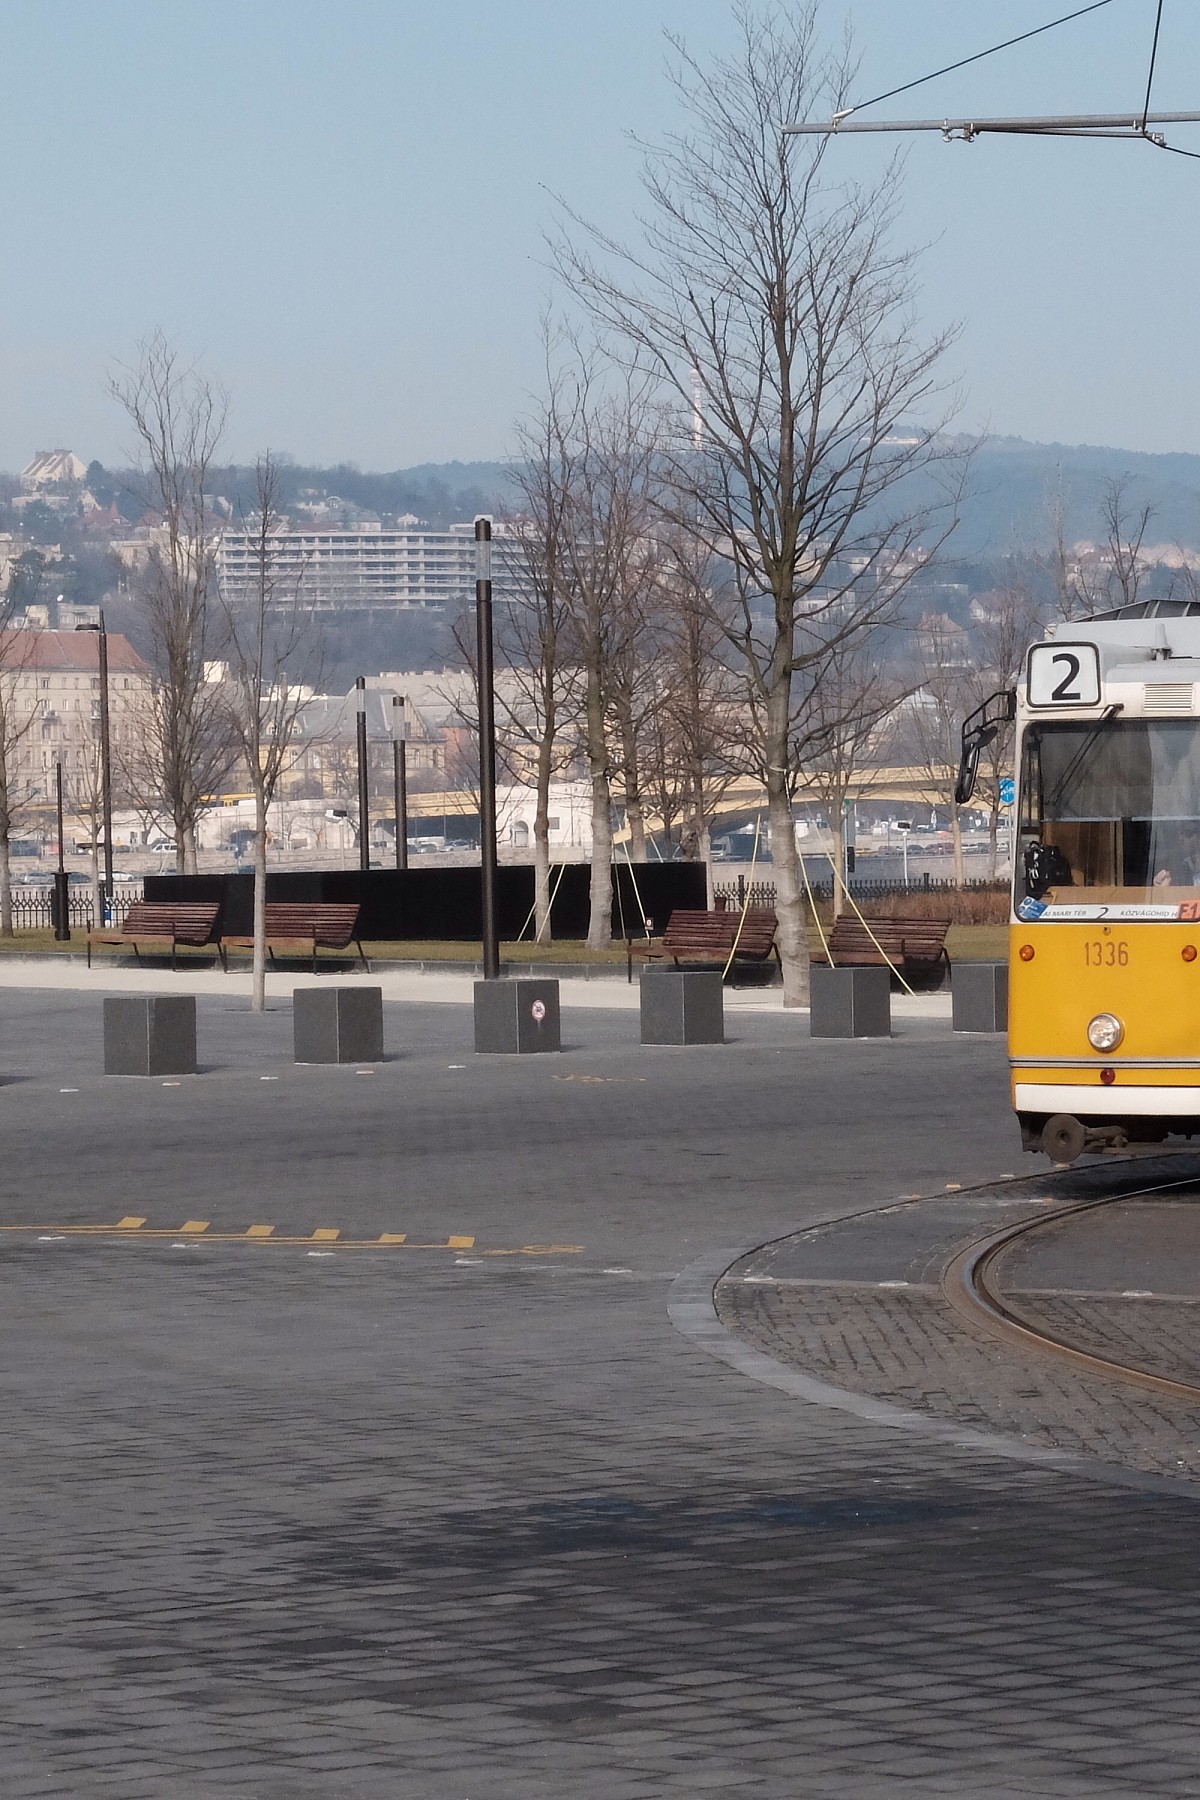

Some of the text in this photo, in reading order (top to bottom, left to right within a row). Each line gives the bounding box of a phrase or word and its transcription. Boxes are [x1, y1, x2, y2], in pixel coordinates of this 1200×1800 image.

[1051, 652, 1082, 701] 2
[1097, 906, 1109, 919] 2
[1084, 942, 1129, 967] 1336
